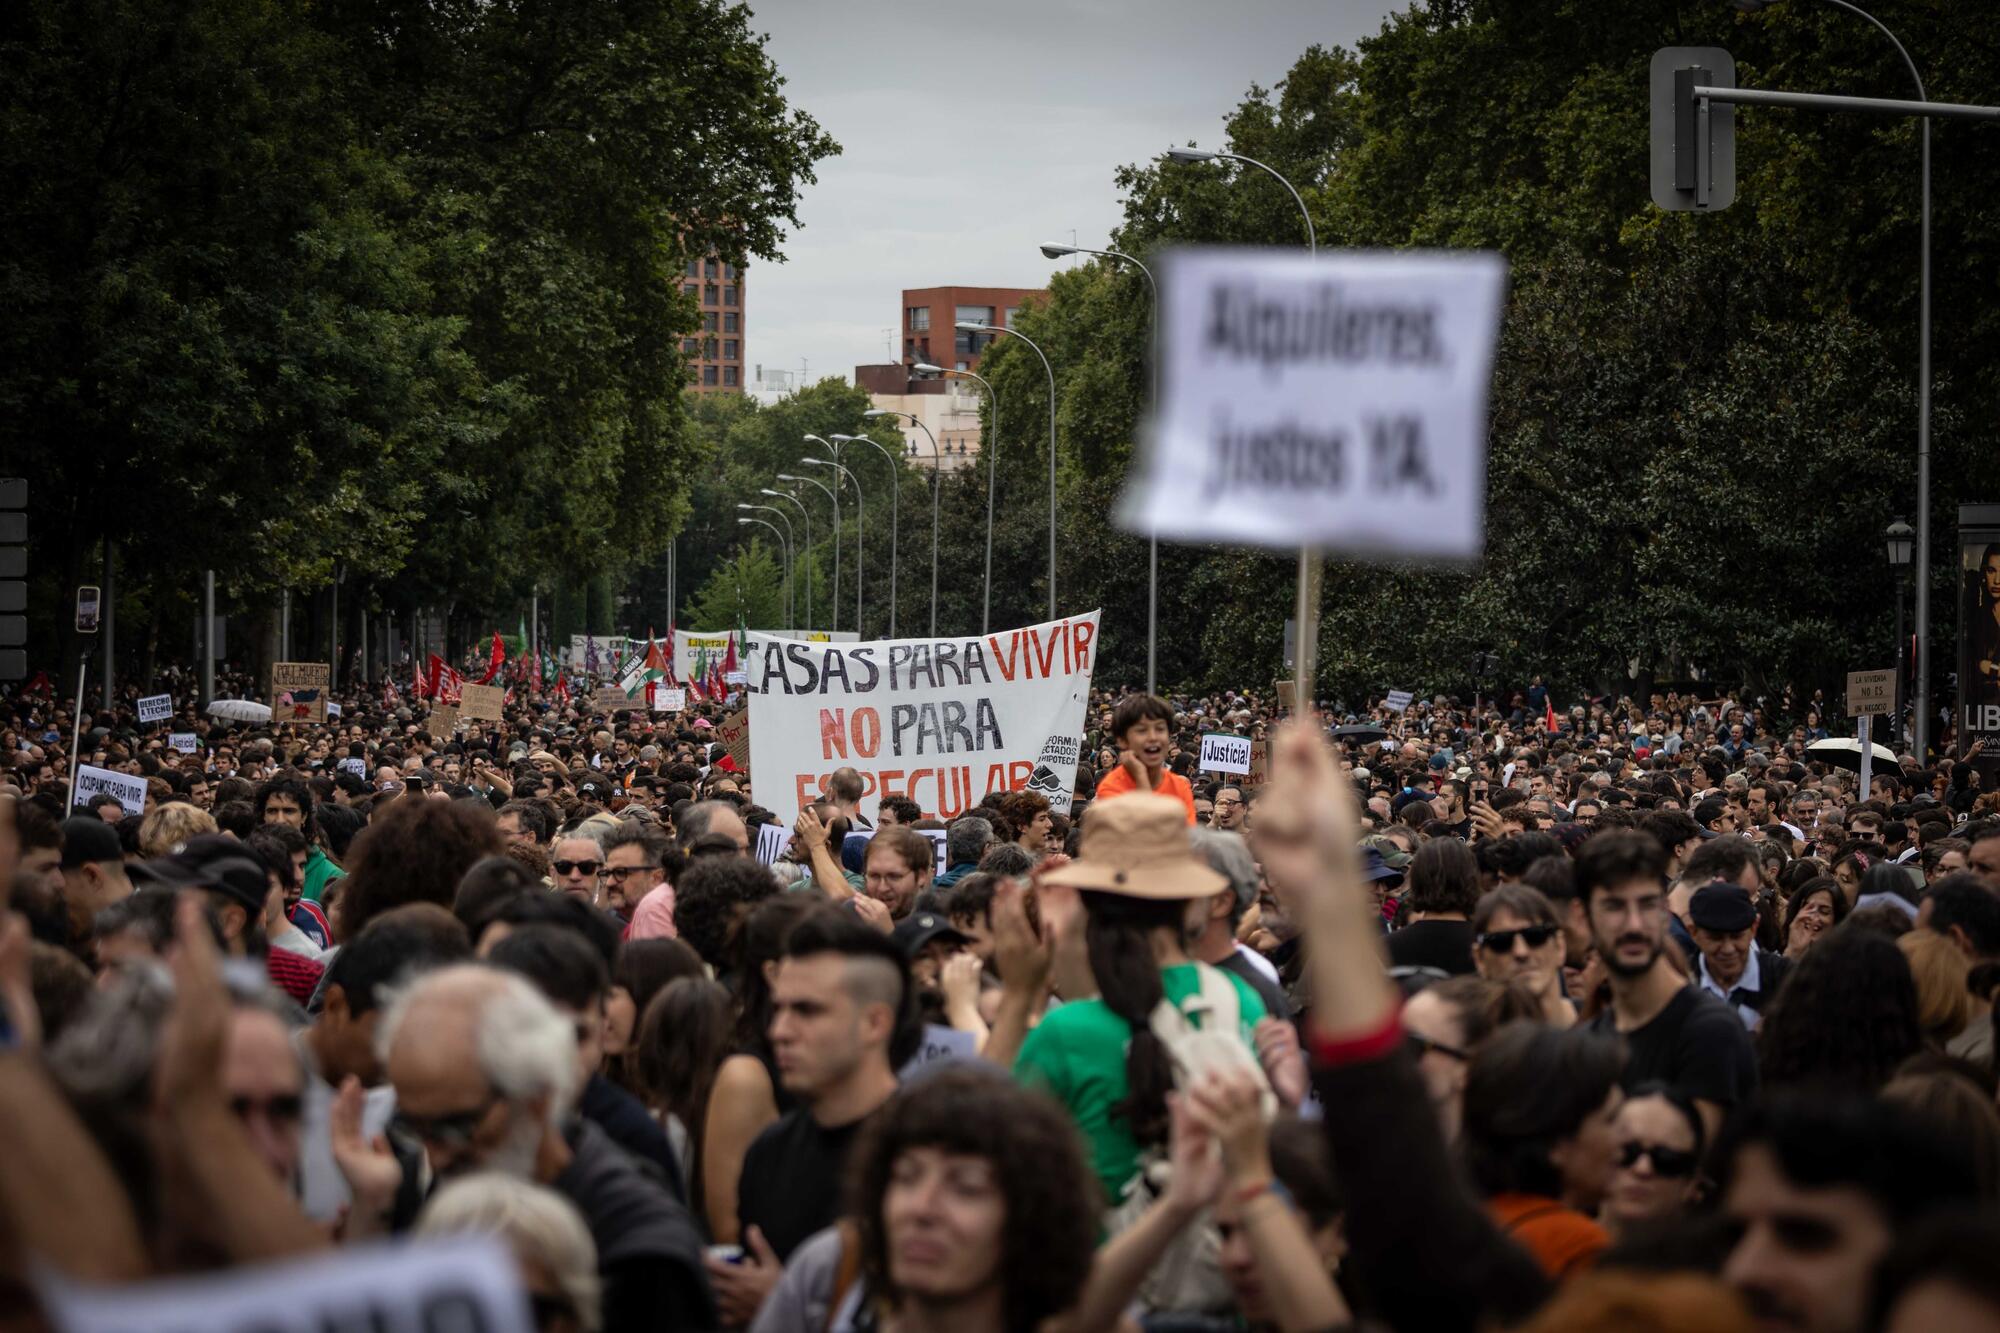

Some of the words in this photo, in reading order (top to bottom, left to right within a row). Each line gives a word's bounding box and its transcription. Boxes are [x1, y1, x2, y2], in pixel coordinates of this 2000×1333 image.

[889, 641, 992, 691] PARA
[1861, 687, 1870, 697] NO
[1874, 686, 1883, 696] ES
[820, 707, 882, 760] NO
[891, 698, 1004, 757] PARA
[1203, 740, 1249, 765] ¡Justicia!
[112, 781, 126, 799] PARA
